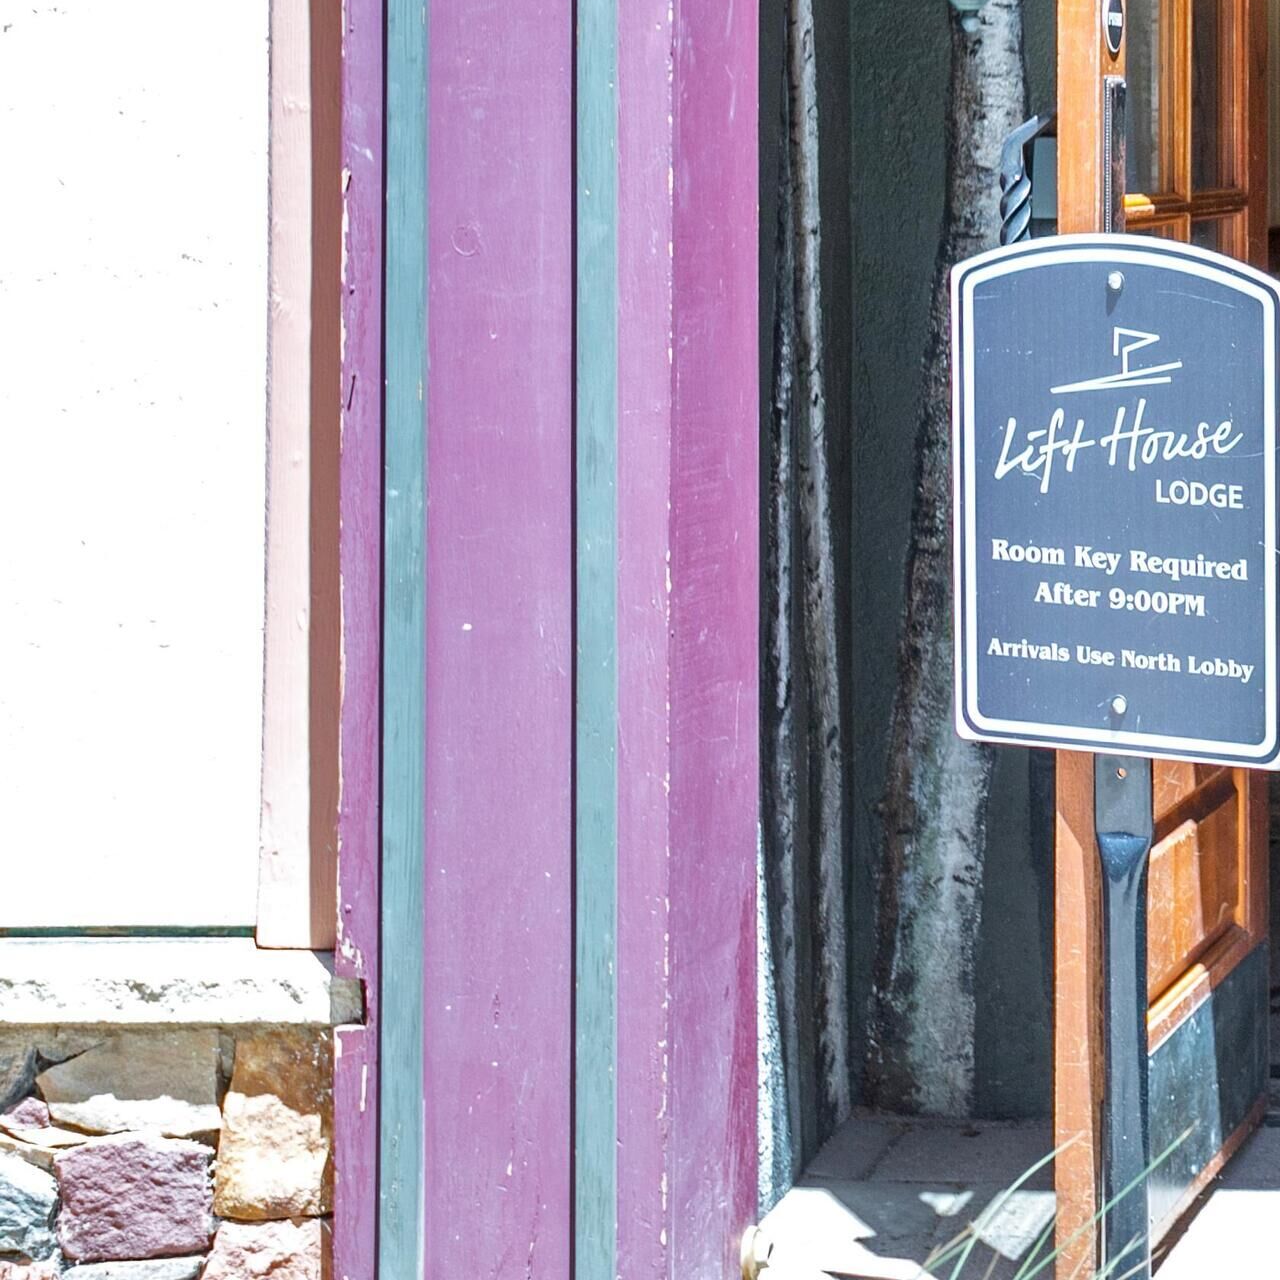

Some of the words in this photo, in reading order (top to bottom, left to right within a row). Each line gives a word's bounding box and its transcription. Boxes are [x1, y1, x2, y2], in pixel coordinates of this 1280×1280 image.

[995, 406, 1094, 494] Lift
[1100, 398, 1245, 473] House
[1155, 480, 1245, 510] LODGE
[991, 539, 1065, 567] Room
[1074, 545, 1122, 577] Key
[1129, 551, 1249, 582] Required
[1034, 581, 1101, 609] After
[1109, 589, 1205, 617] 9:00PM
[987, 638, 1069, 664] Arrivals
[1076, 646, 1115, 667] Use
[1120, 649, 1181, 673] North
[1187, 654, 1255, 683] Lobby
